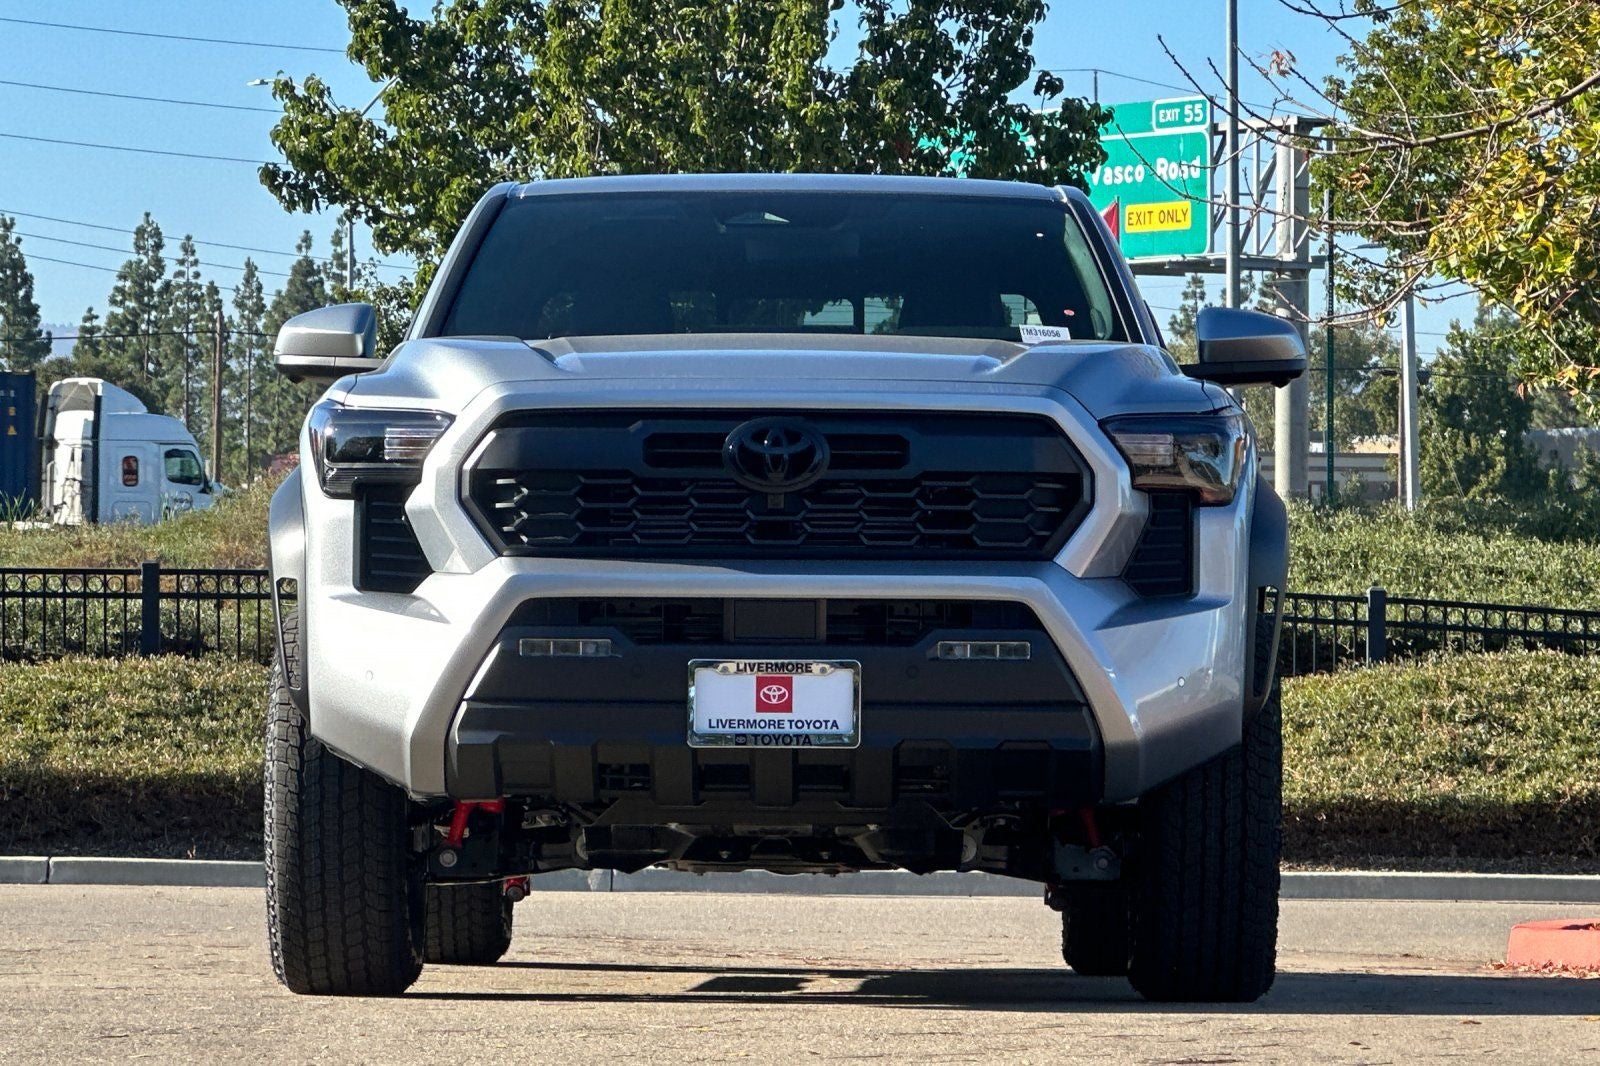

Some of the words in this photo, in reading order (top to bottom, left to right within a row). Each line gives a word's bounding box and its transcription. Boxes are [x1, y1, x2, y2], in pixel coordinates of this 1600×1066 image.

[1159, 108, 1181, 122] EXIT
[1184, 104, 1204, 122] 55
[1091, 164, 1146, 186] Vasco
[1156, 155, 1201, 181] Road
[1127, 211, 1154, 226] EXIT
[1158, 208, 1189, 224] ONLY
[736, 662, 813, 674] LIVERMORE
[708, 718, 785, 730] LIVERMORE
[787, 719, 840, 730] TOYOTA
[751, 733, 813, 746] TOYOTA
